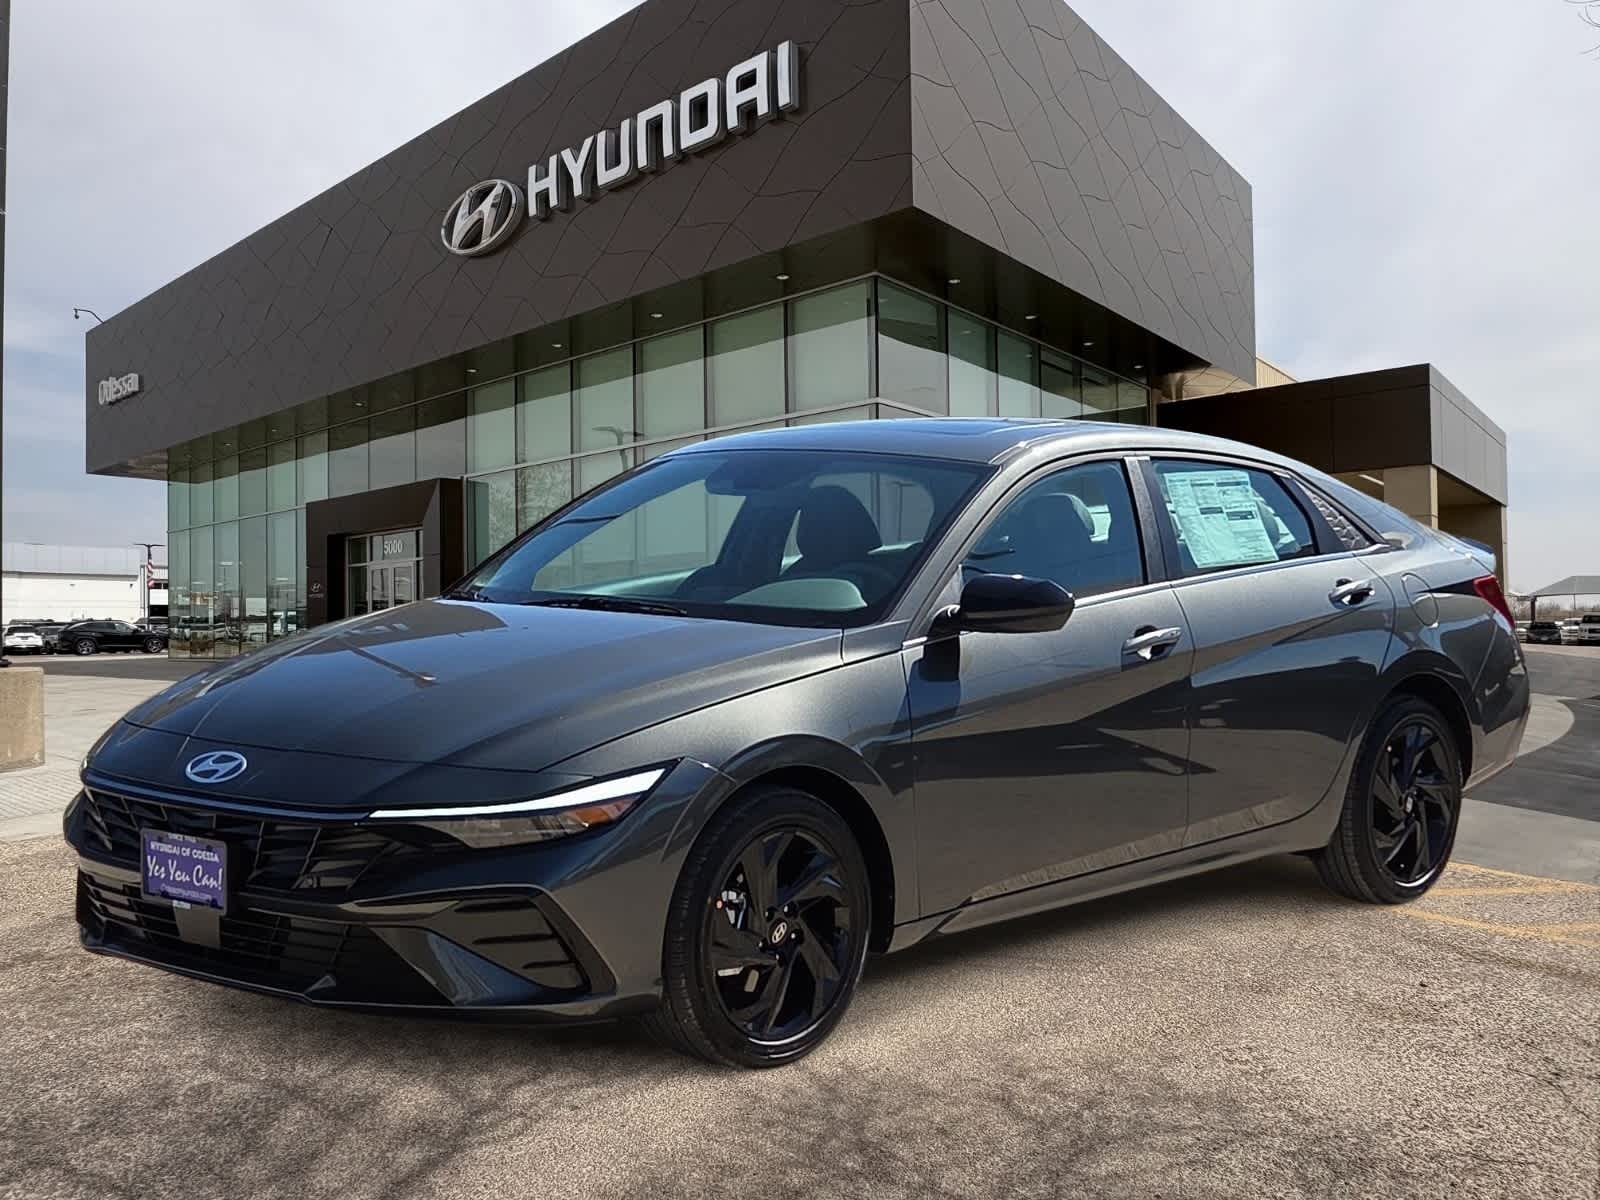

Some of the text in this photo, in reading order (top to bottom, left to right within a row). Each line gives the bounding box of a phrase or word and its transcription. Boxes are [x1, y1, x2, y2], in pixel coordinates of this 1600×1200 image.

[527, 40, 798, 218] HYUNDAI
[384, 539, 403, 554] 5000
[181, 847, 191, 857] OF
[147, 855, 223, 890] Yes You Can!
